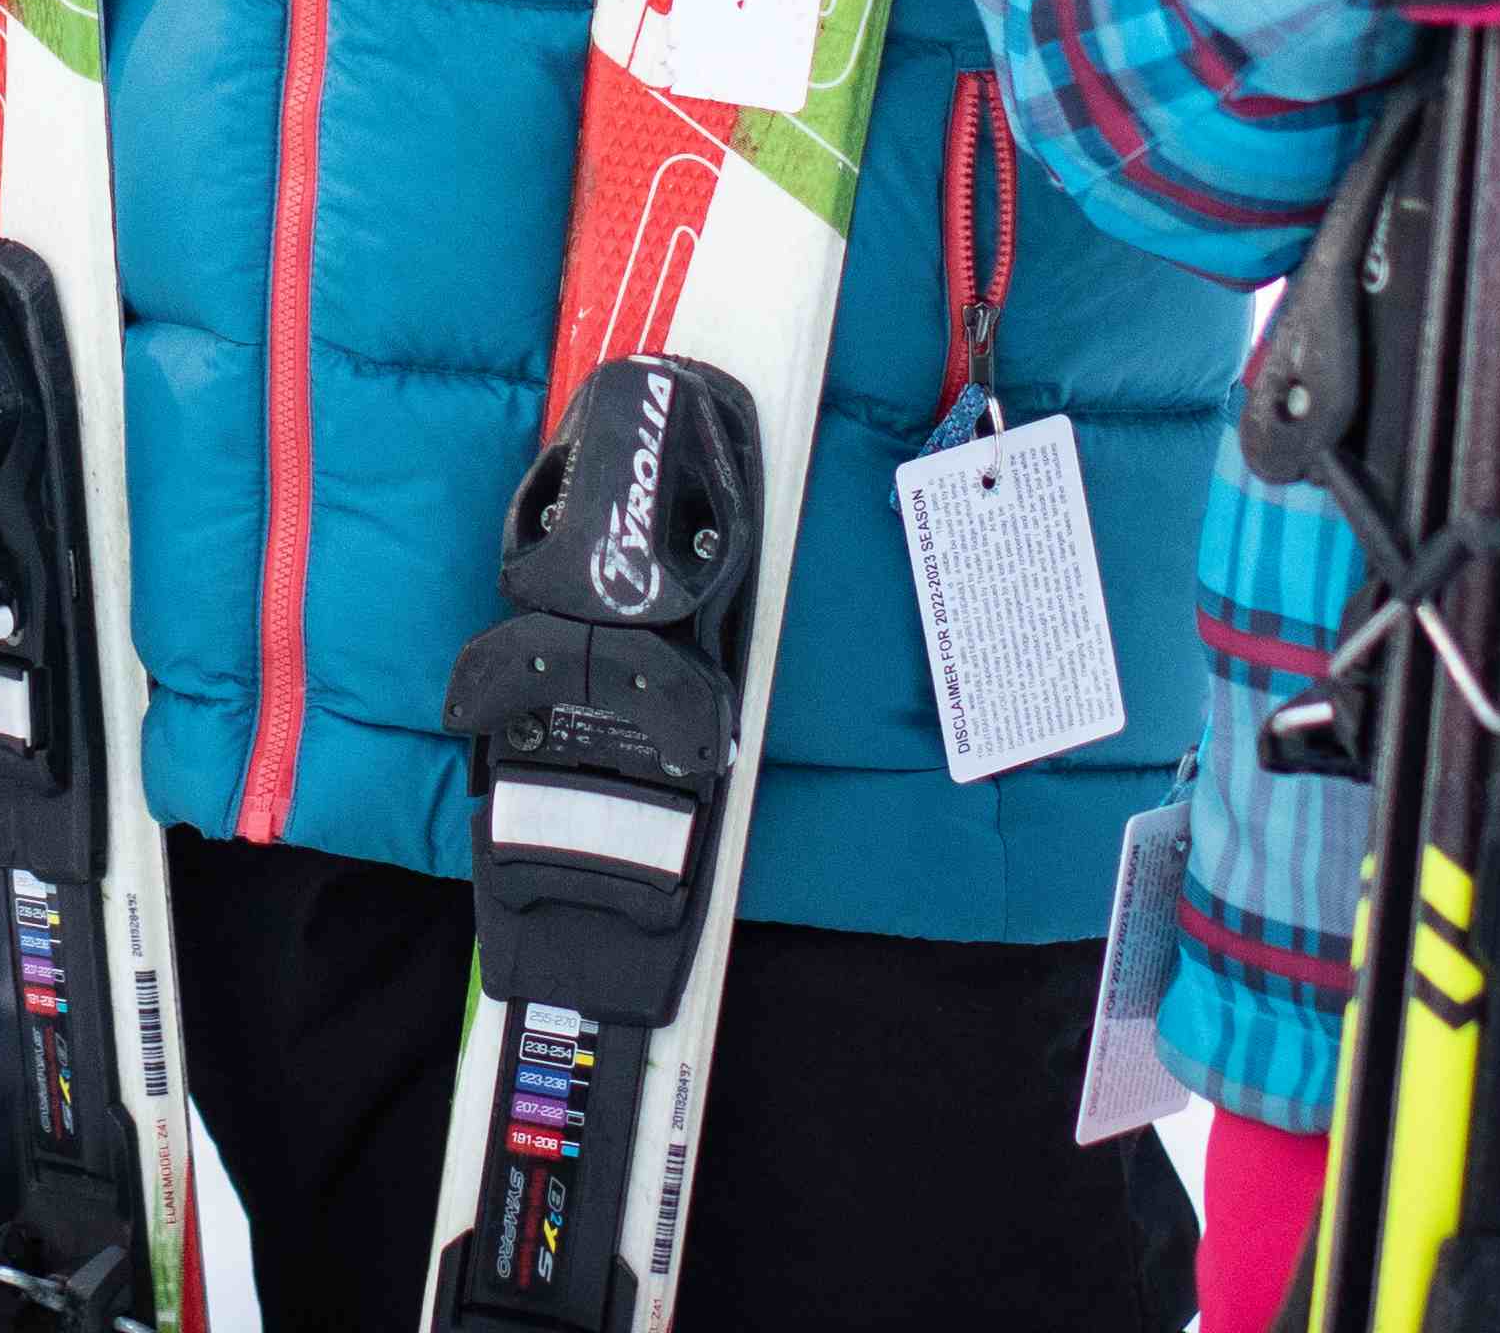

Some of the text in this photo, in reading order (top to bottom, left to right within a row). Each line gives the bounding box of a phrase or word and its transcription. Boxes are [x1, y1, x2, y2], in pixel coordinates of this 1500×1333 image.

[591, 373, 676, 617] TYROLIA
[910, 488, 934, 551] SEASON
[922, 553, 948, 625] 2022-2023
[936, 628, 954, 661] FOR
[941, 662, 971, 754] DISCLAIMER
[157, 1144, 173, 1188] MODEL
[163, 1190, 177, 1224] ELAN
[494, 1165, 526, 1279] SYMPRO
